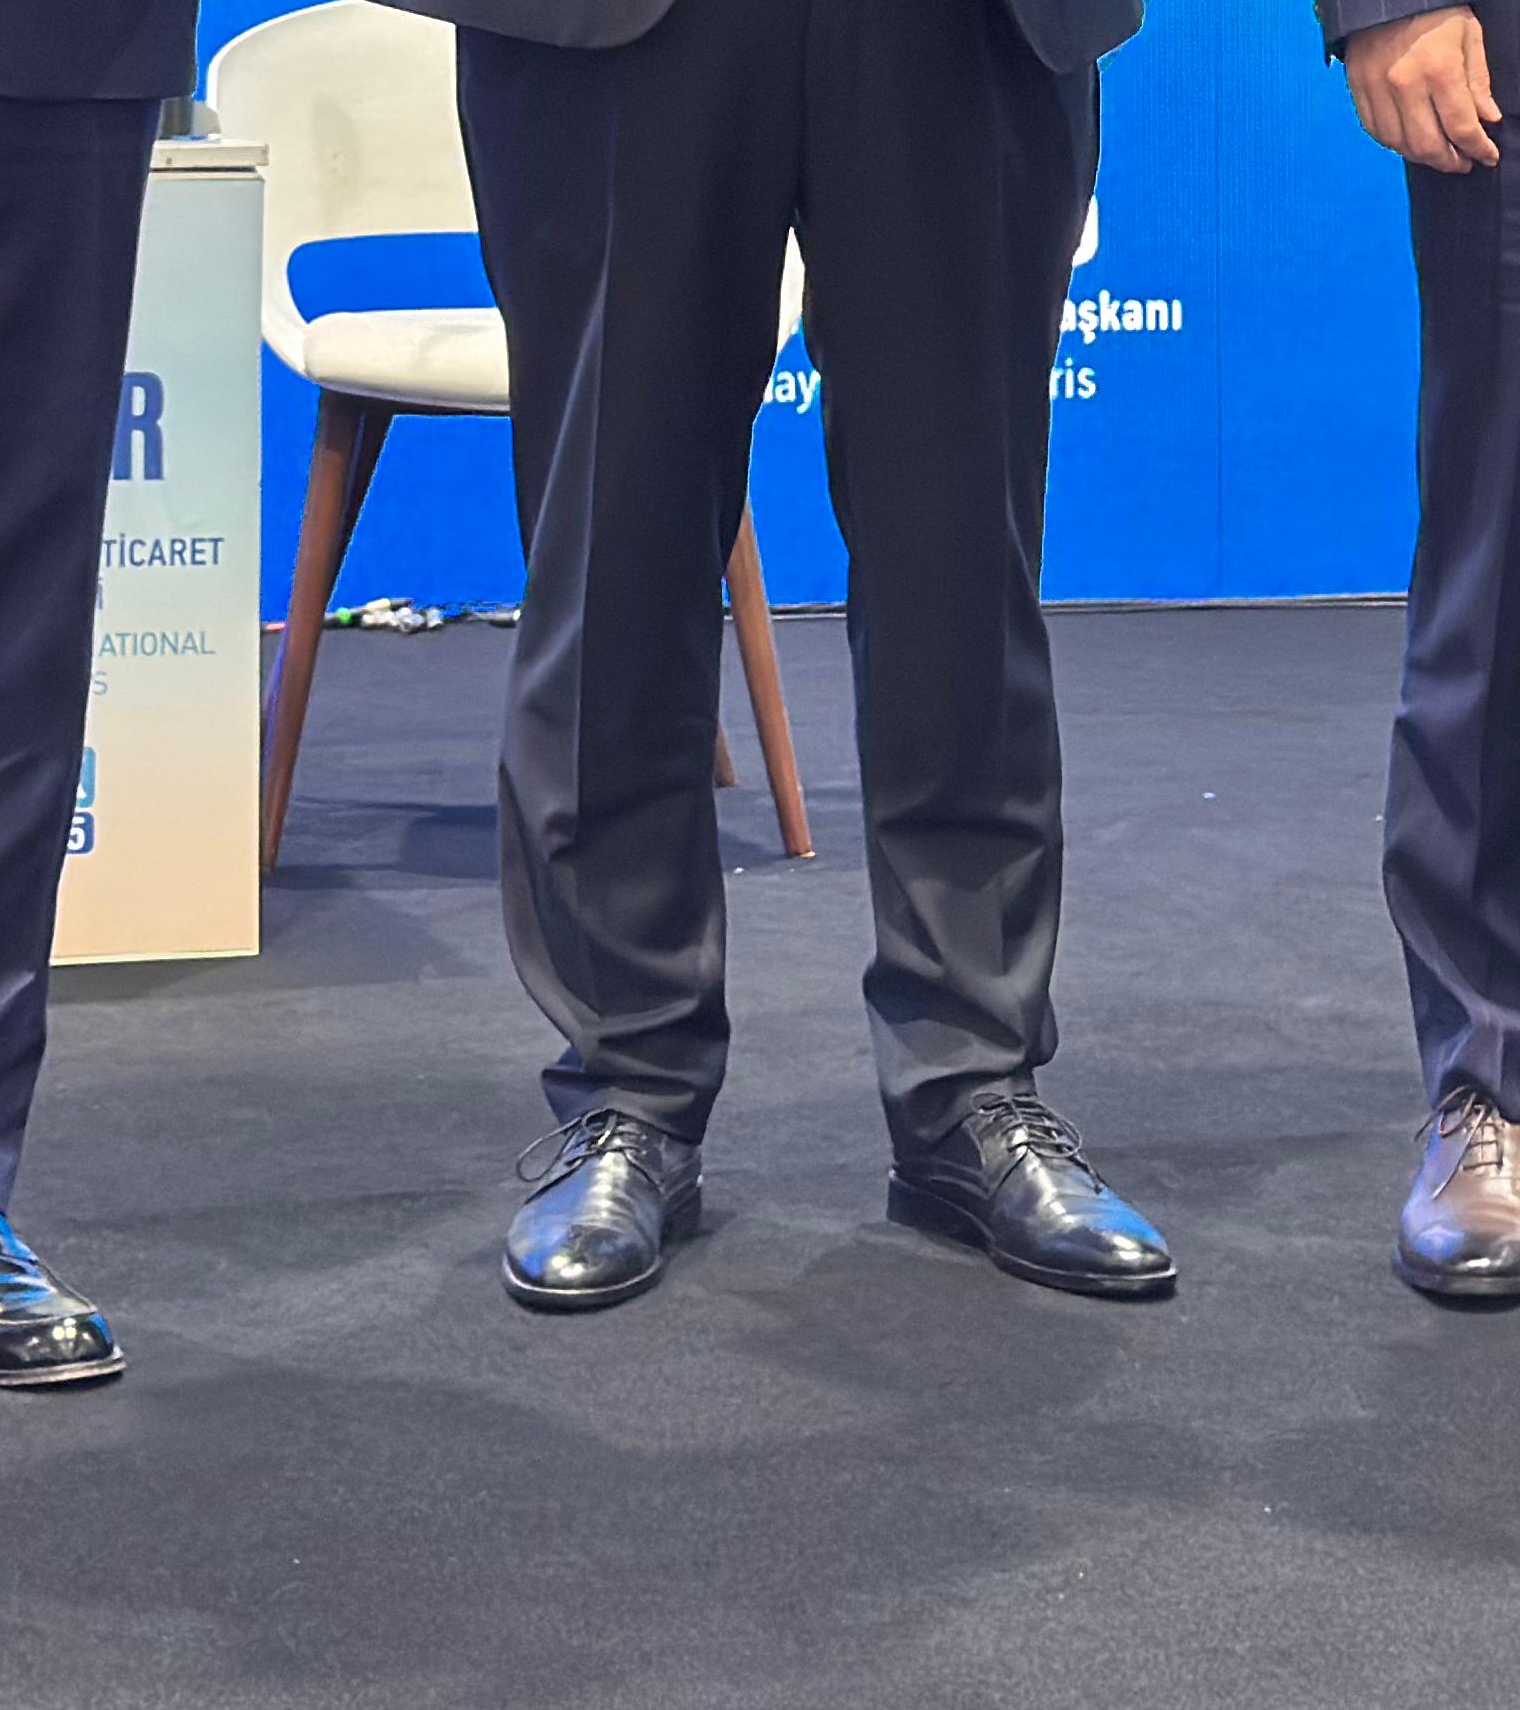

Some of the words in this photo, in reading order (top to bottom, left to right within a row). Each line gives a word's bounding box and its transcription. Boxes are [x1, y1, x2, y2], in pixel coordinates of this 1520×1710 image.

[1060, 290, 1181, 344] aşkanı
[103, 533, 225, 568] TİCARET
[98, 630, 217, 658] ATIONAL
